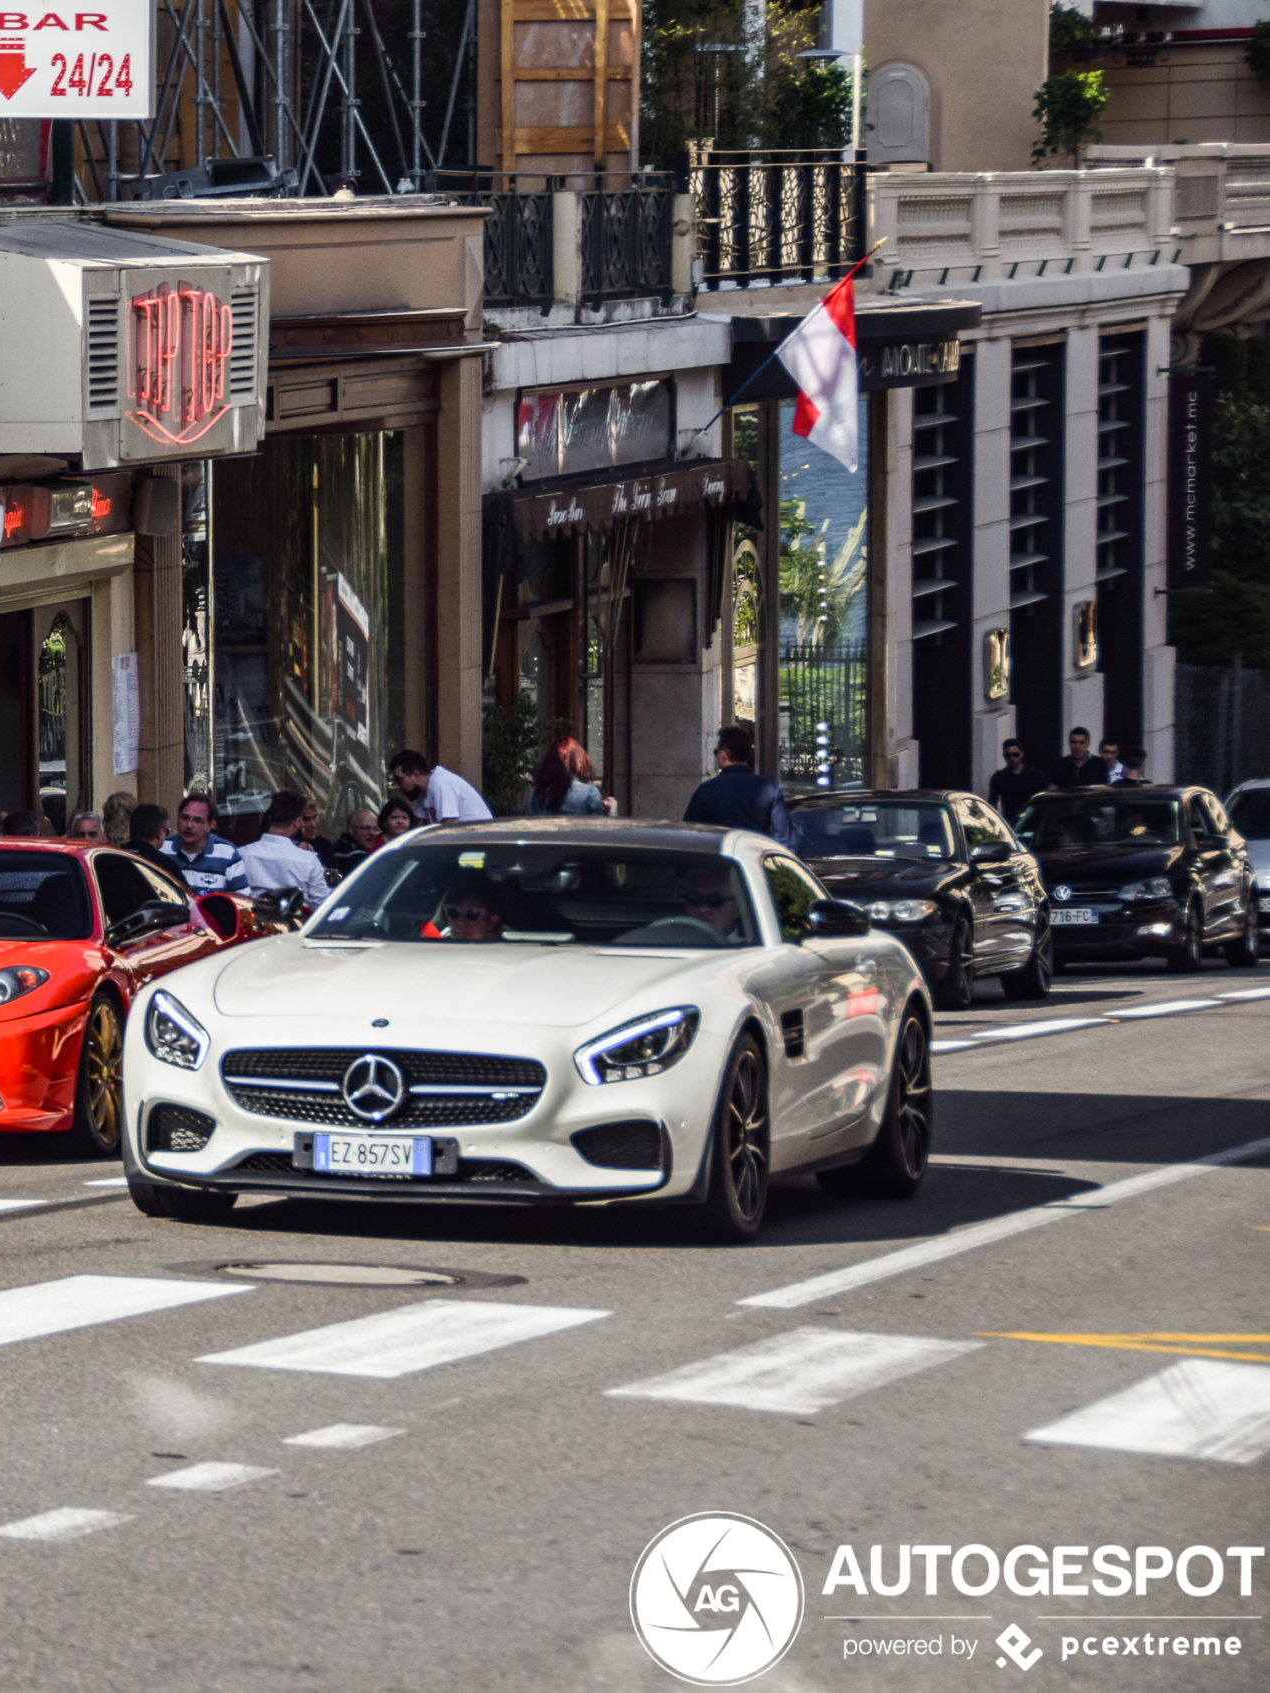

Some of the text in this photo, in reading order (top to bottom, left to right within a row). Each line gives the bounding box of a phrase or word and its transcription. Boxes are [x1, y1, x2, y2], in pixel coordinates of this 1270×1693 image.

[49, 52, 133, 97] 24/24
[1186, 391, 1198, 571] www.mcmarket.mc
[331, 1142, 351, 1163] EZ
